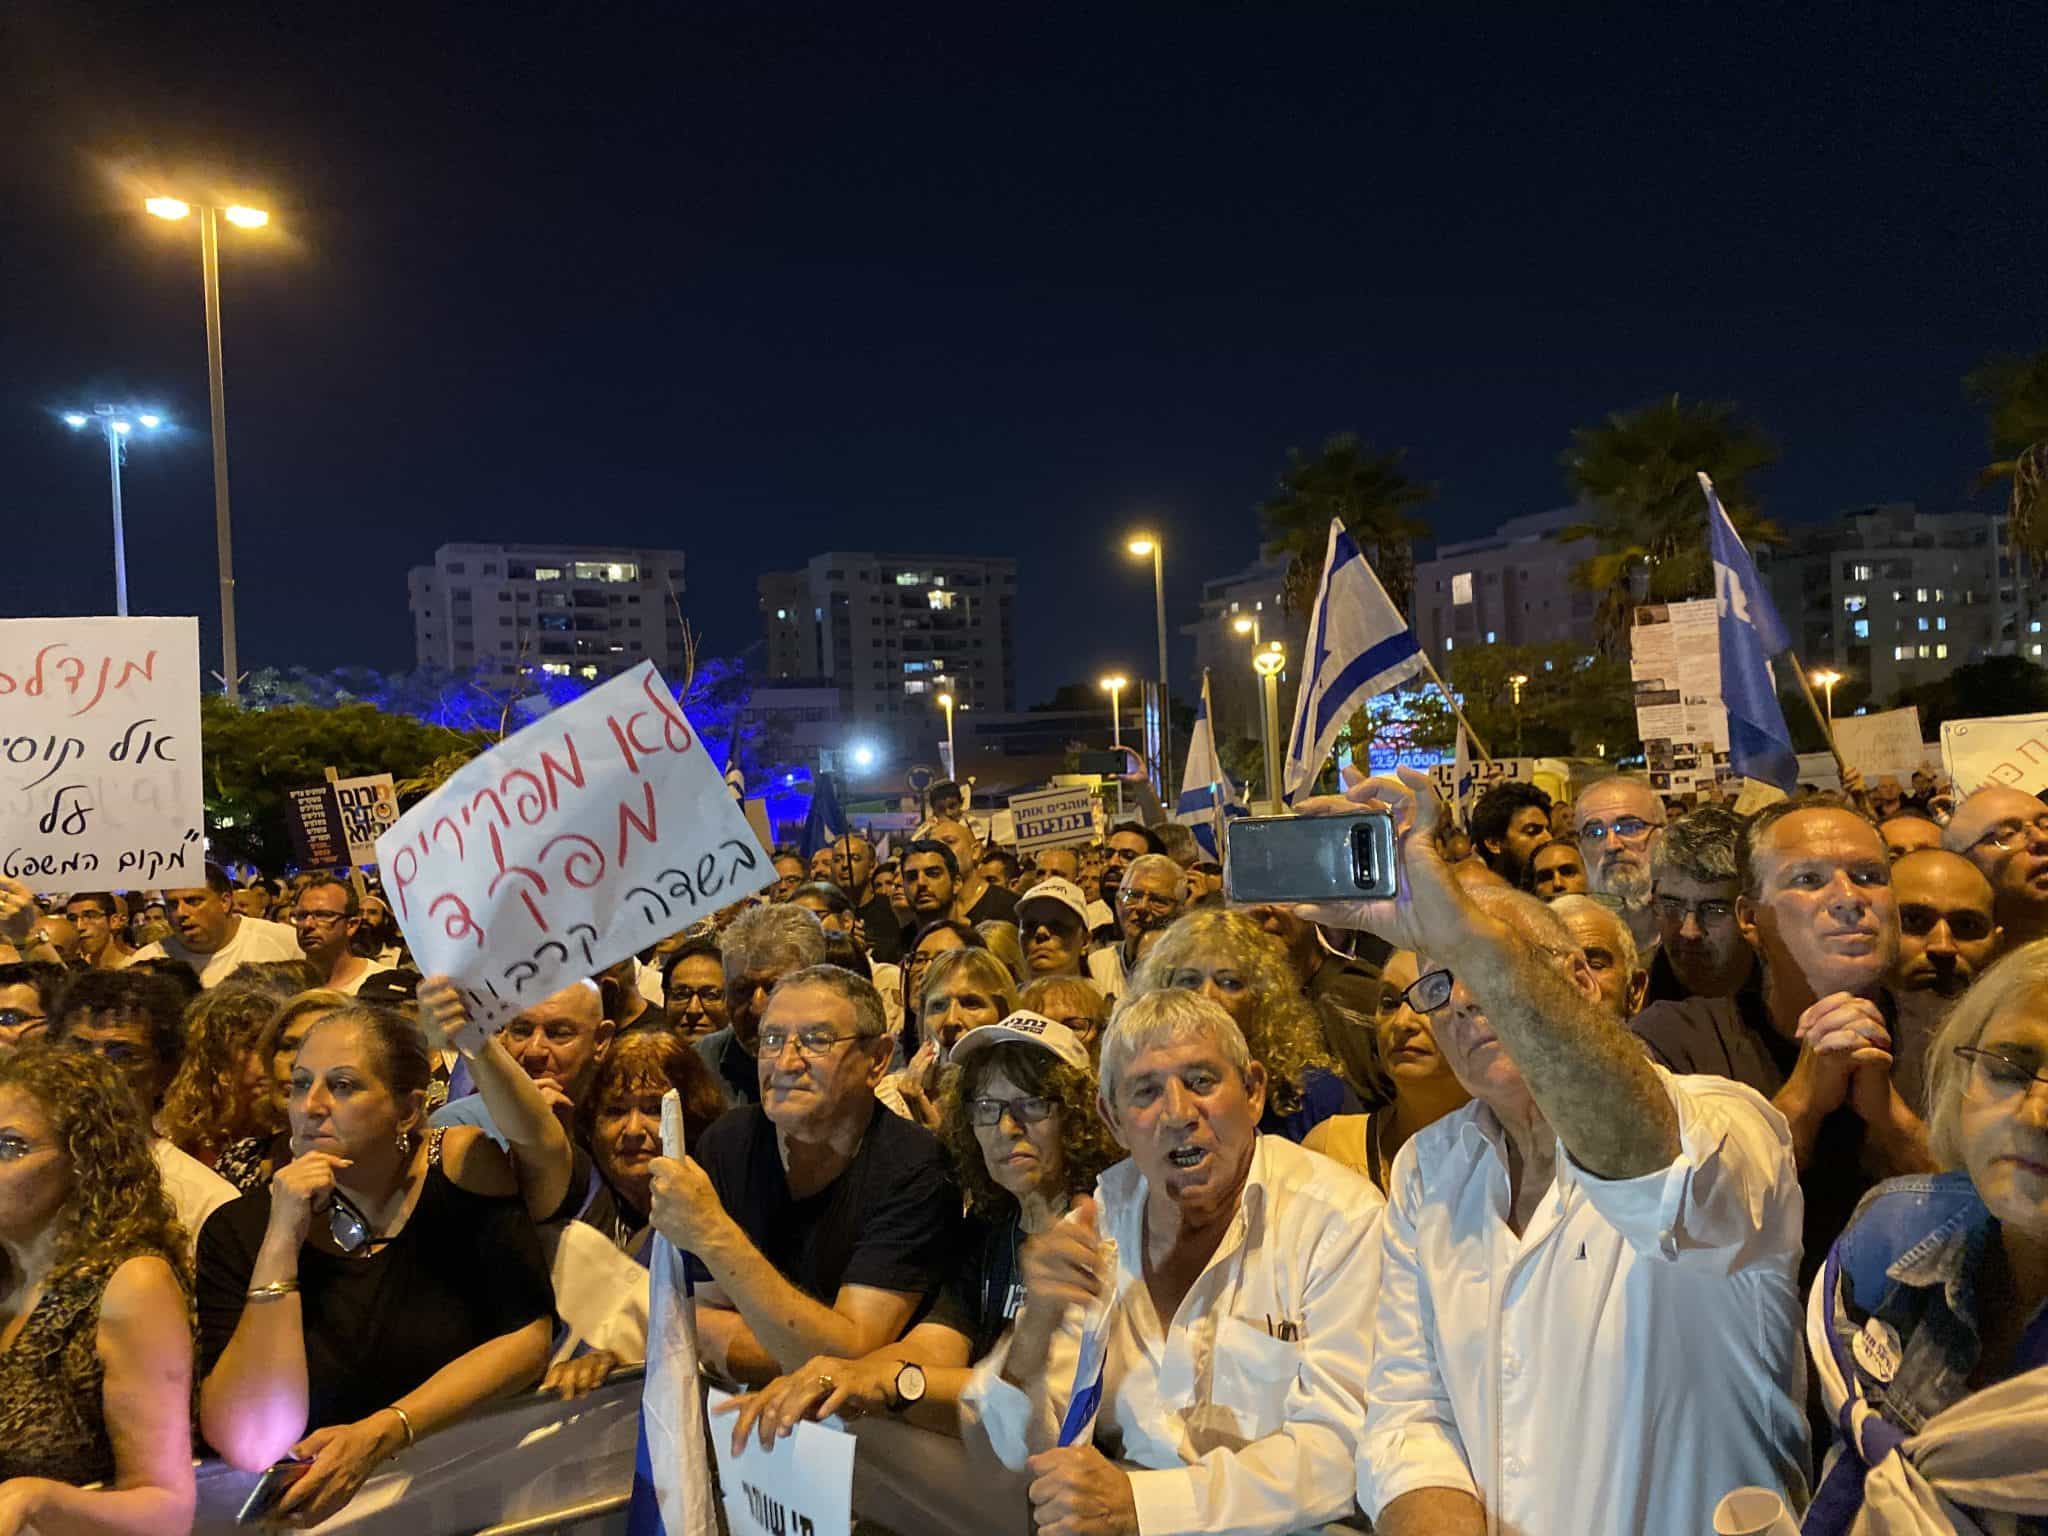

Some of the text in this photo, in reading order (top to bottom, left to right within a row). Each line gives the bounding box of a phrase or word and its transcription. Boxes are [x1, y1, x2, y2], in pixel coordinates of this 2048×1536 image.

[109, 719, 177, 764] אל
[608, 669, 692, 774] לא
[40, 785, 95, 835] על
[1014, 799, 1089, 821] אוהבים אותך
[1022, 815, 1086, 838] נתניהו
[4, 848, 99, 879] המשפט
[626, 840, 757, 925] בשדה
